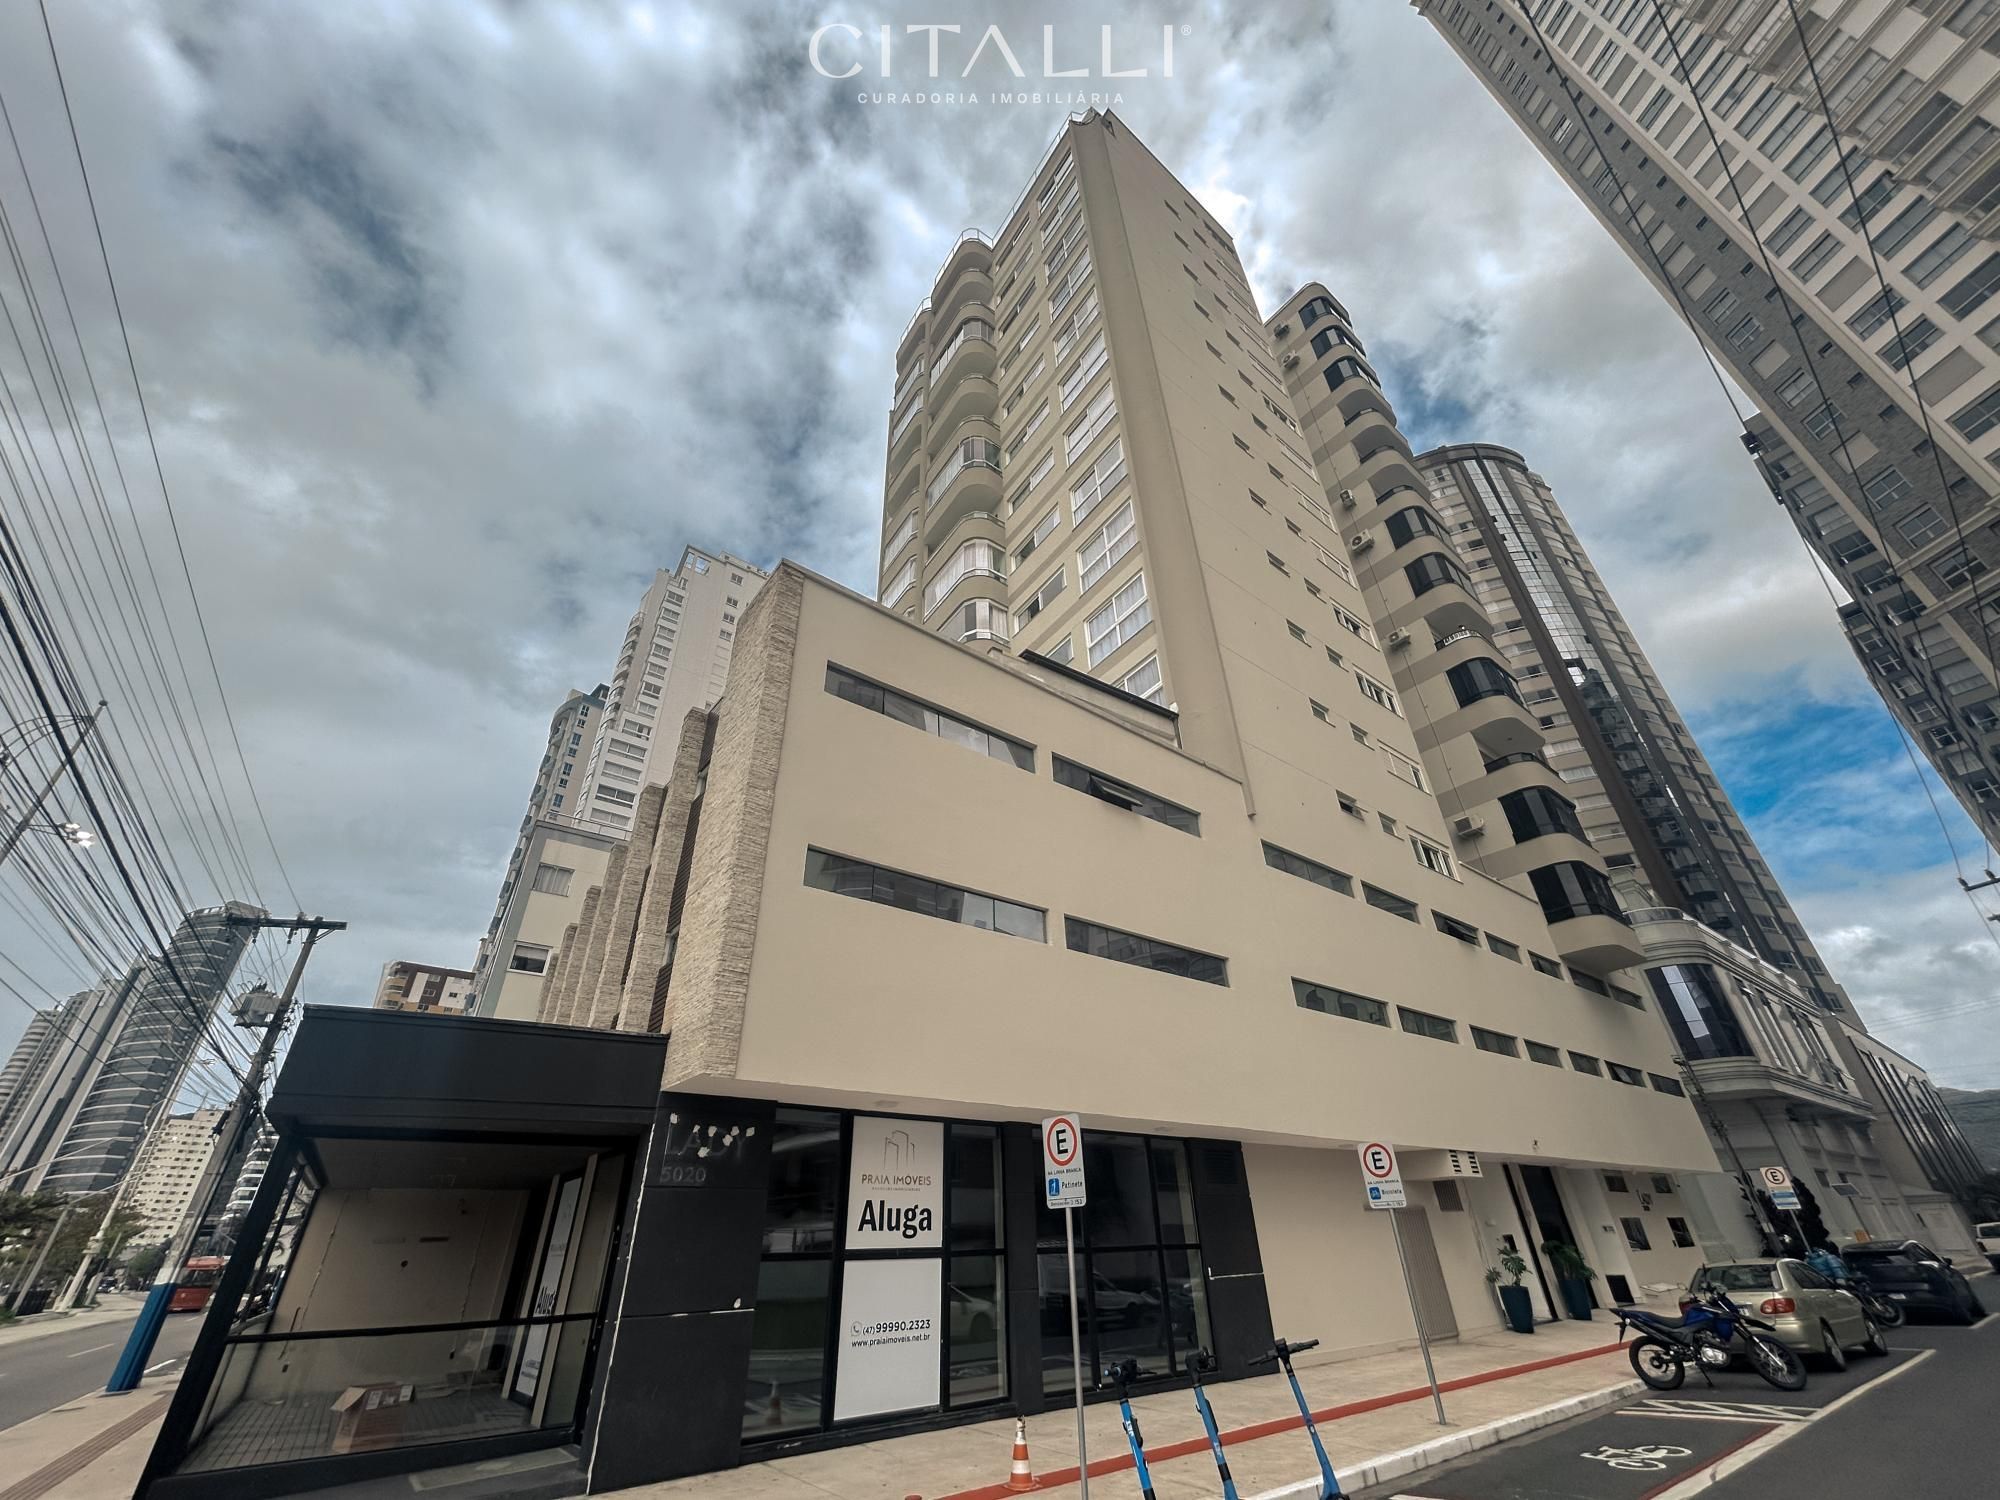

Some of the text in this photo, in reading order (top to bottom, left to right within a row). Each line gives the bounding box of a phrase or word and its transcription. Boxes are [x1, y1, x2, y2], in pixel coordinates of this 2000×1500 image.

[1056, 1129, 1068, 1154] E
[1371, 1152, 1385, 1169] E
[661, 1166, 706, 1183] 5020
[862, 1174, 890, 1185] PRAIA
[1770, 1171, 1780, 1182] E
[858, 1199, 932, 1239] Aluga
[851, 1333, 930, 1347] www.praiaimoveis.net.br
